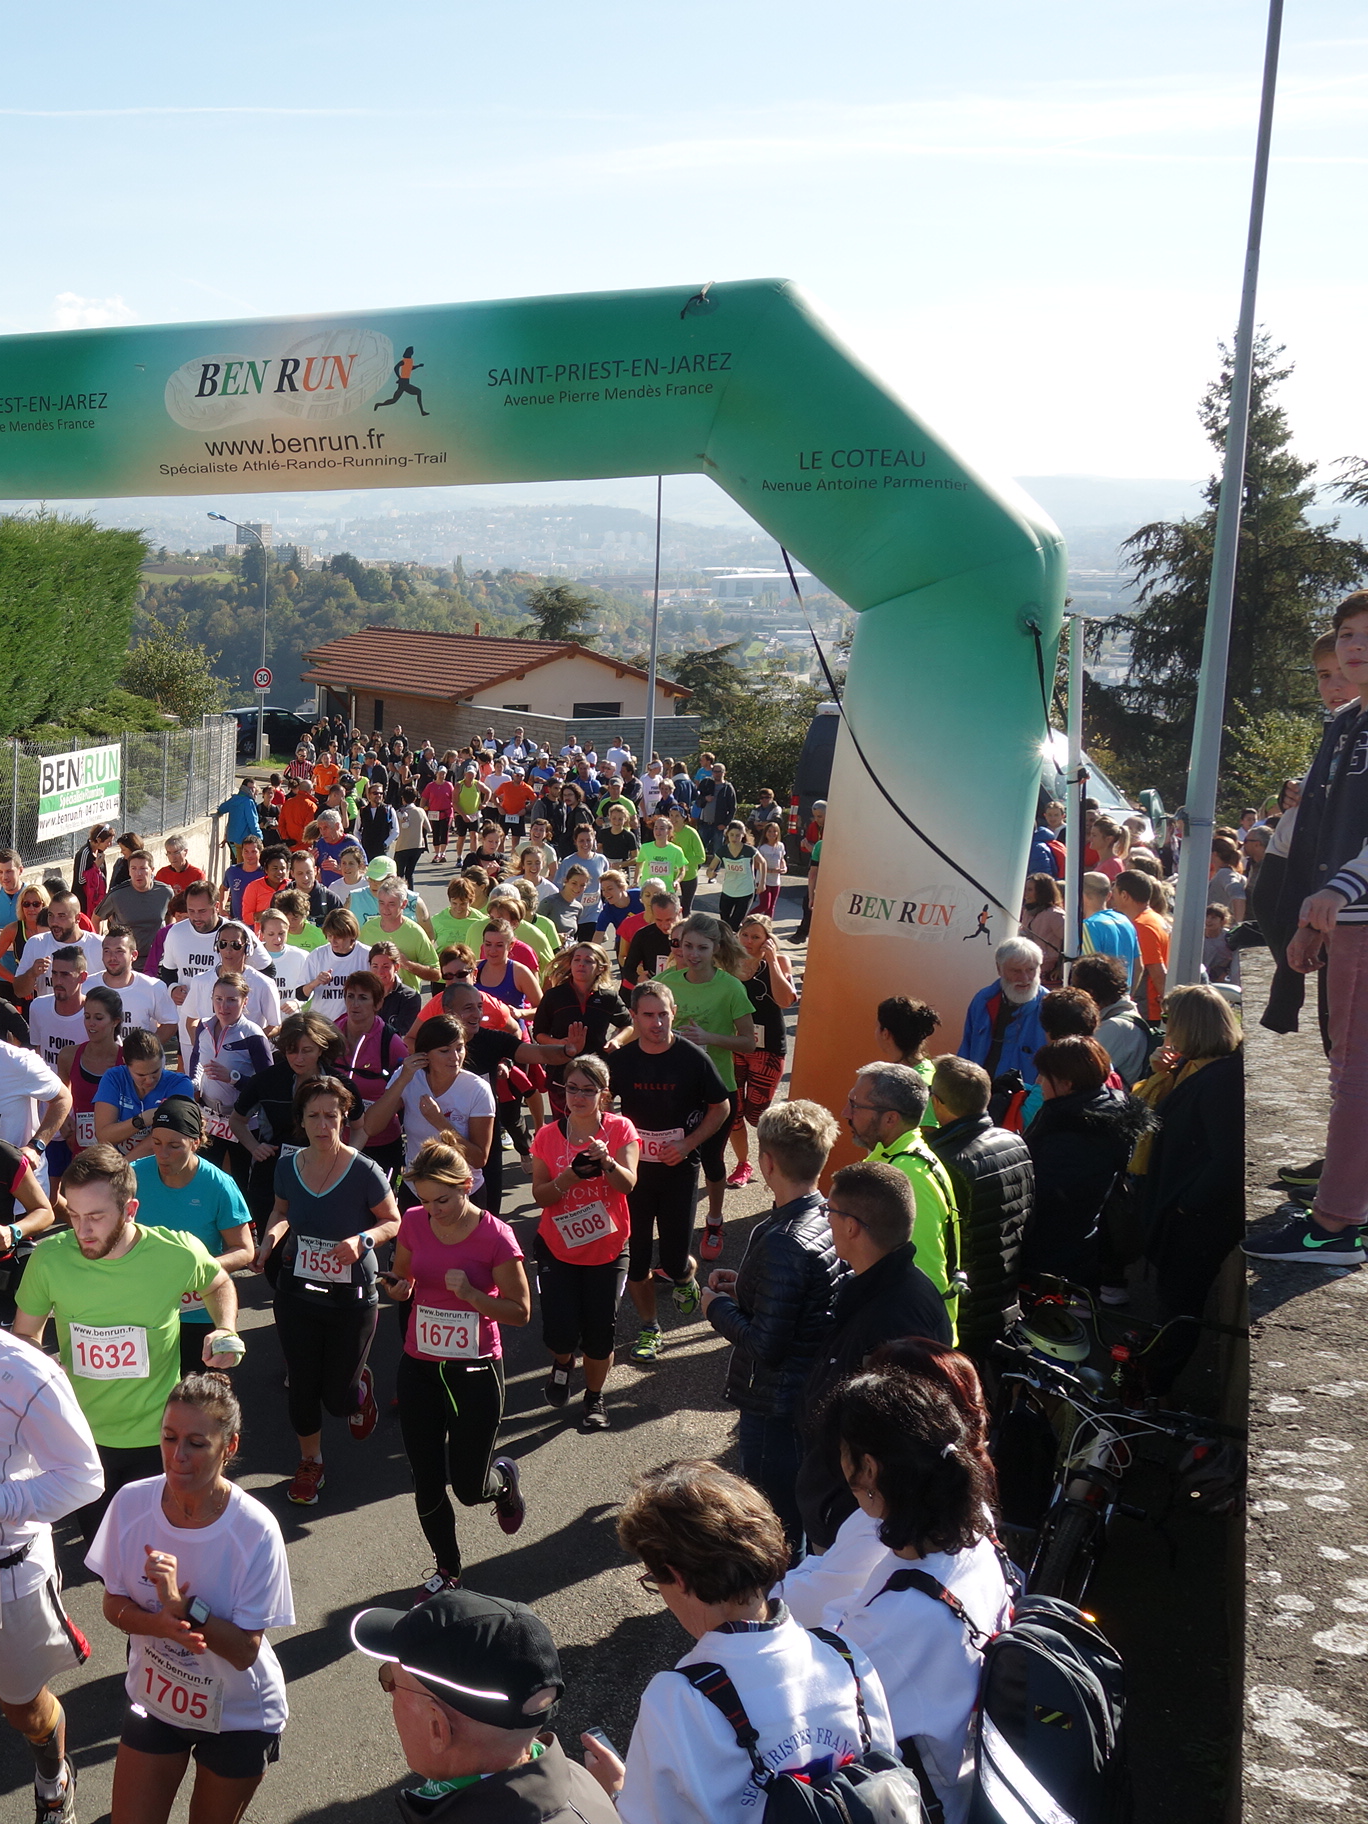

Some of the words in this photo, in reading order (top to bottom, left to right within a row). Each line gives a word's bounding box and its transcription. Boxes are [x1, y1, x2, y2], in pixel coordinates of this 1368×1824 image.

[195, 359, 272, 398] BEN
[274, 354, 358, 393] RUN
[488, 352, 732, 386] SAINT-PRIEST-EN-JAREZ
[503, 394, 554, 407] Avenue
[559, 390, 600, 403] Pierre
[604, 385, 661, 400] Mendès
[666, 383, 713, 397] France
[9, 418, 54, 432] Mendès
[57, 418, 95, 430] France
[204, 428, 385, 457] www.benrun.fr
[159, 461, 238, 477] Spécialiste
[242, 452, 447, 473] Athlé-Rando-Running-Trail
[799, 451, 823, 470] LE
[831, 449, 926, 468] COTEAU
[762, 479, 812, 492] Avenue
[816, 477, 878, 491] Antoine
[883, 475, 968, 491] Parmentier
[257, 673, 269, 683] 30
[651, 865, 668, 873] 1604
[848, 893, 896, 921] BEN
[897, 901, 956, 926] RUN
[189, 954, 215, 966] POUR
[328, 976, 347, 987] POU
[634, 1083, 676, 1091] MILLET
[208, 1119, 234, 1140] 720
[555, 1203, 596, 1221] www.benrun.fr
[562, 1213, 606, 1240] 1608
[300, 1250, 343, 1274] 1553
[419, 1307, 471, 1320] www.benrun.fr
[73, 1326, 135, 1337] www.benrun.fr
[420, 1321, 469, 1348] 1673
[77, 1341, 137, 1369] 1632
[144, 1646, 213, 1686] www.benrun.fr
[144, 1667, 208, 1720] 1705
